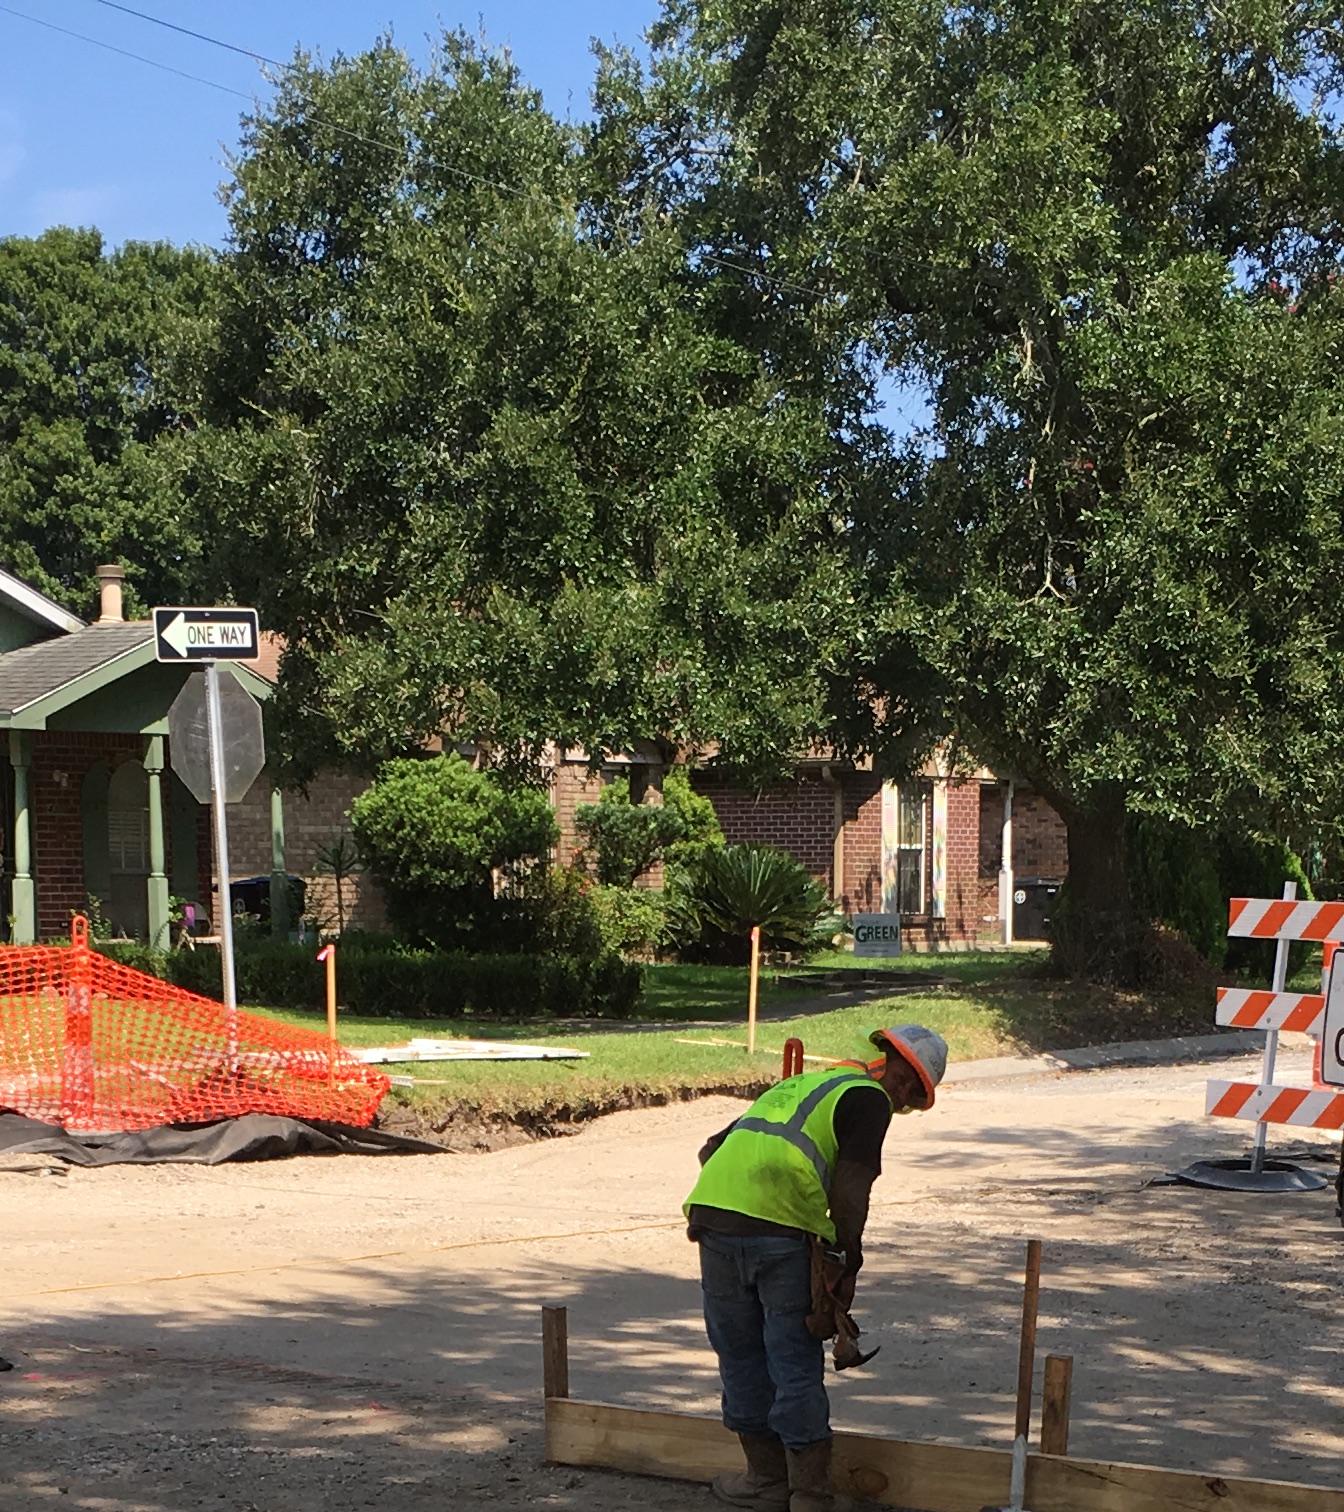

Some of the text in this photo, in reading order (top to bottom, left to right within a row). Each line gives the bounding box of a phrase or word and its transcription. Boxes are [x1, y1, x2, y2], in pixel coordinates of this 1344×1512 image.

[187, 625, 247, 645] ONE WAY
[855, 925, 899, 943] GREEN
